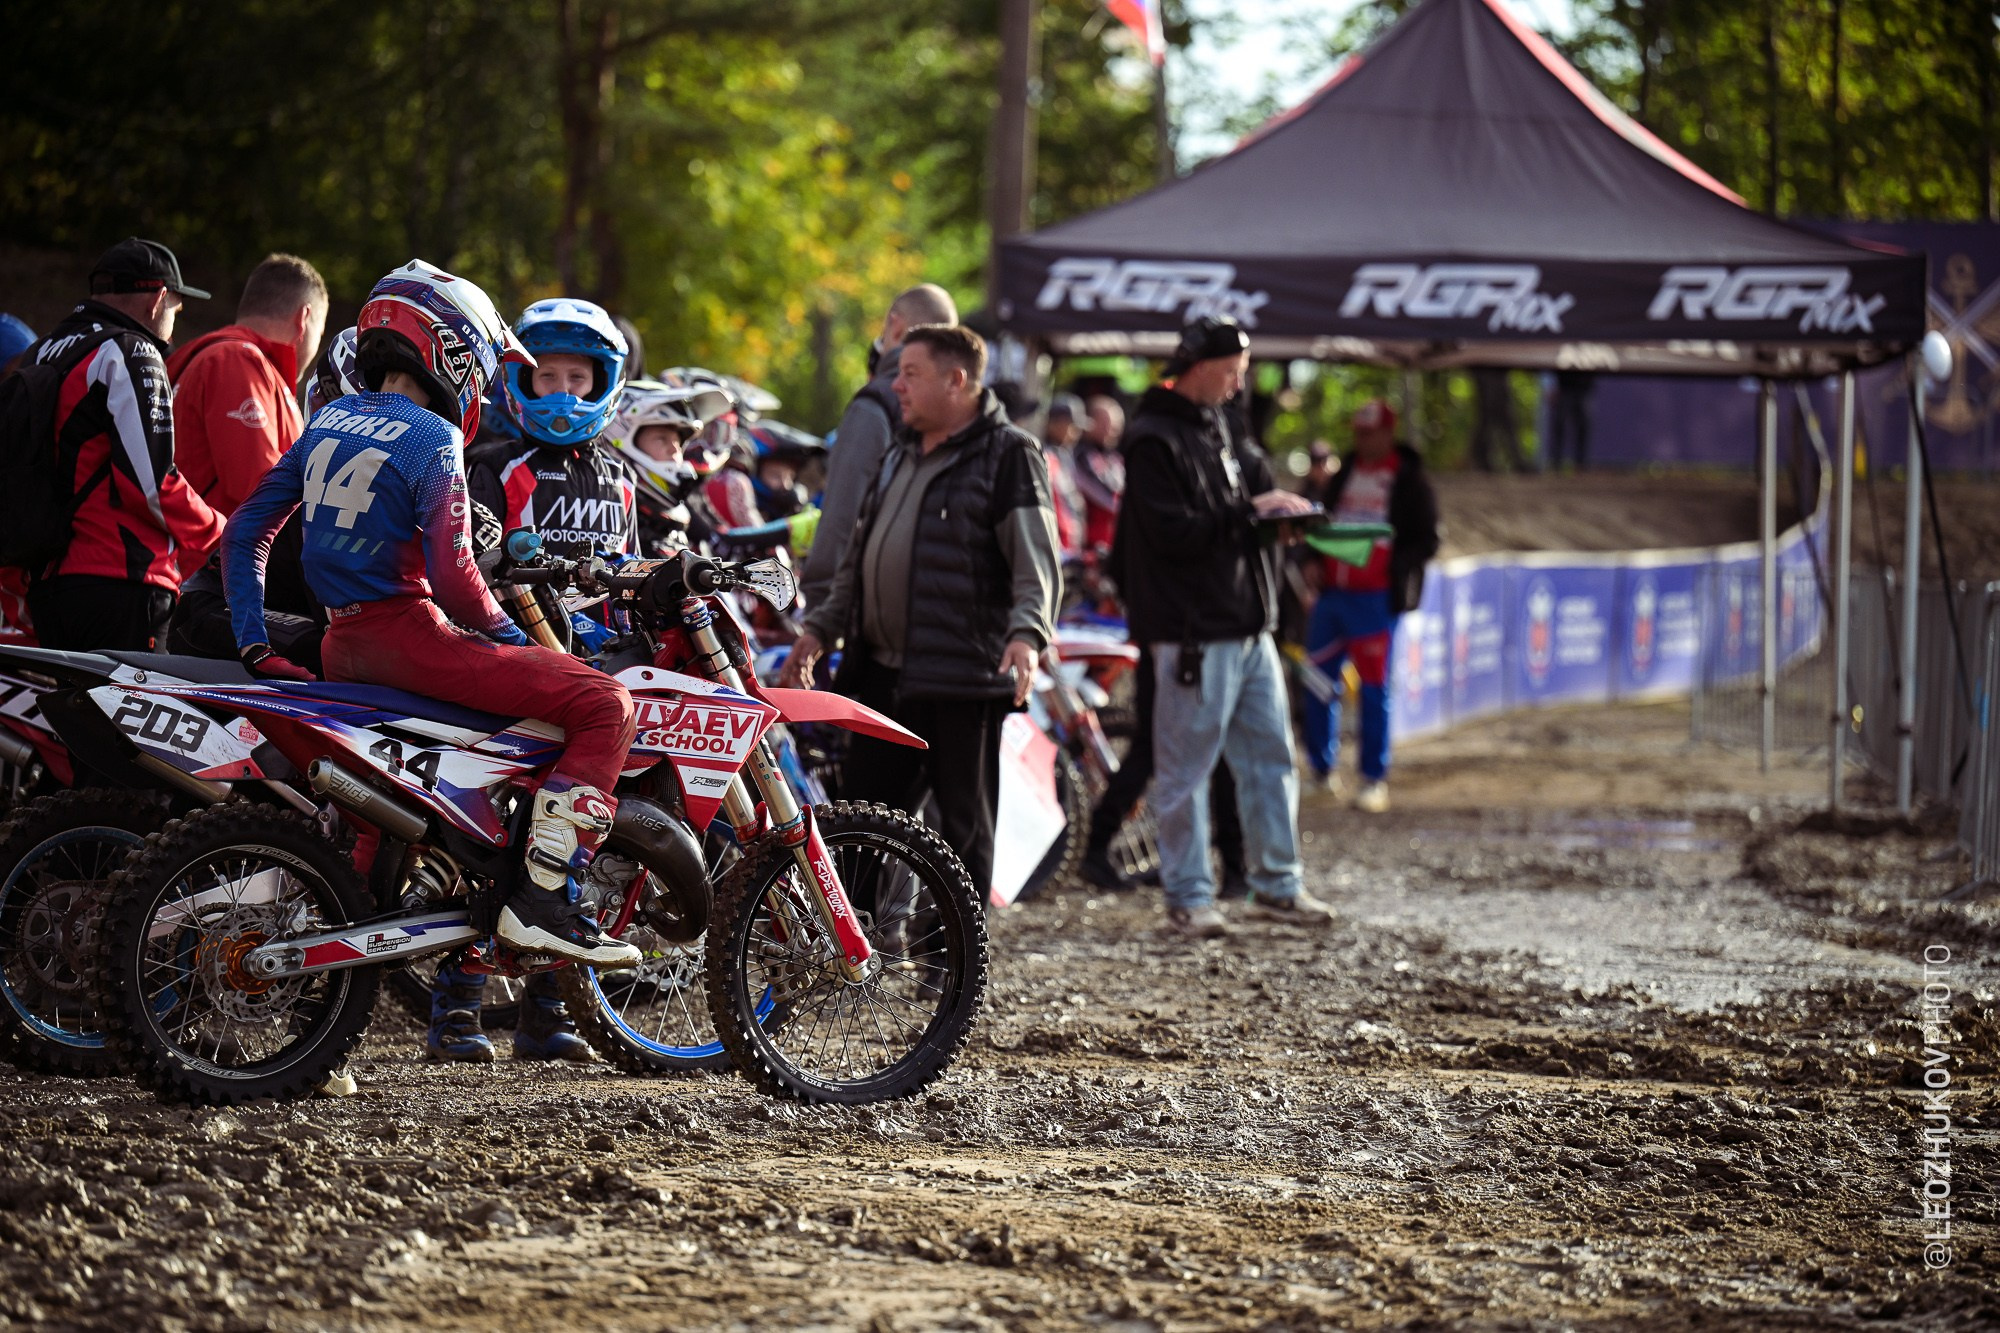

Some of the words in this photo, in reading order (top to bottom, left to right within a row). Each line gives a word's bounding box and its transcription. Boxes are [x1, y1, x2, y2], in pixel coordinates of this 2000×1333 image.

[461, 324, 494, 368] OAKLEY
[303, 437, 392, 530] 44
[112, 695, 210, 752] 203
[369, 738, 441, 794] 44
[338, 780, 370, 802] HGS
[632, 813, 666, 831] HGS
[367, 944, 397, 953] SERVICE
[368, 937, 411, 948] SUSPENSION
